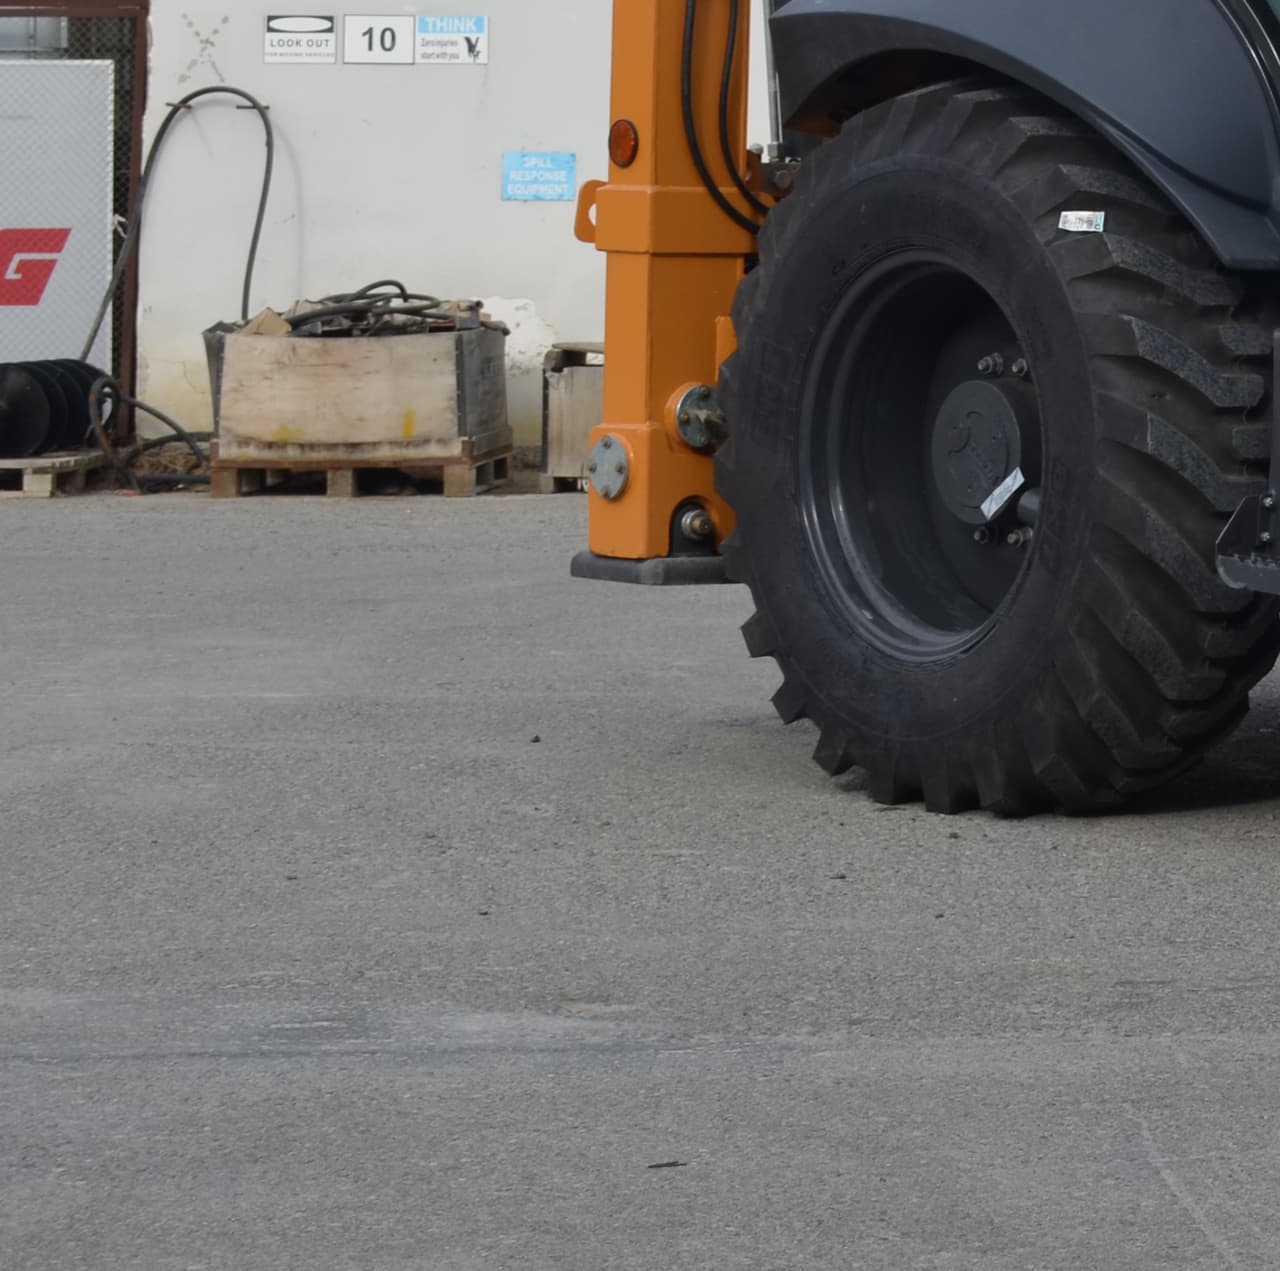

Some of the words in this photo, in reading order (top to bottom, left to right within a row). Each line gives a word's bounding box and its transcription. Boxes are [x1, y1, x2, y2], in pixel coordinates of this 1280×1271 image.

[425, 16, 477, 33] THINK
[269, 39, 302, 49] LOOK
[306, 39, 330, 49] OUT
[362, 26, 397, 52] 10
[509, 170, 567, 182] RESPONSE
[507, 183, 568, 194] EQUIPMENT
